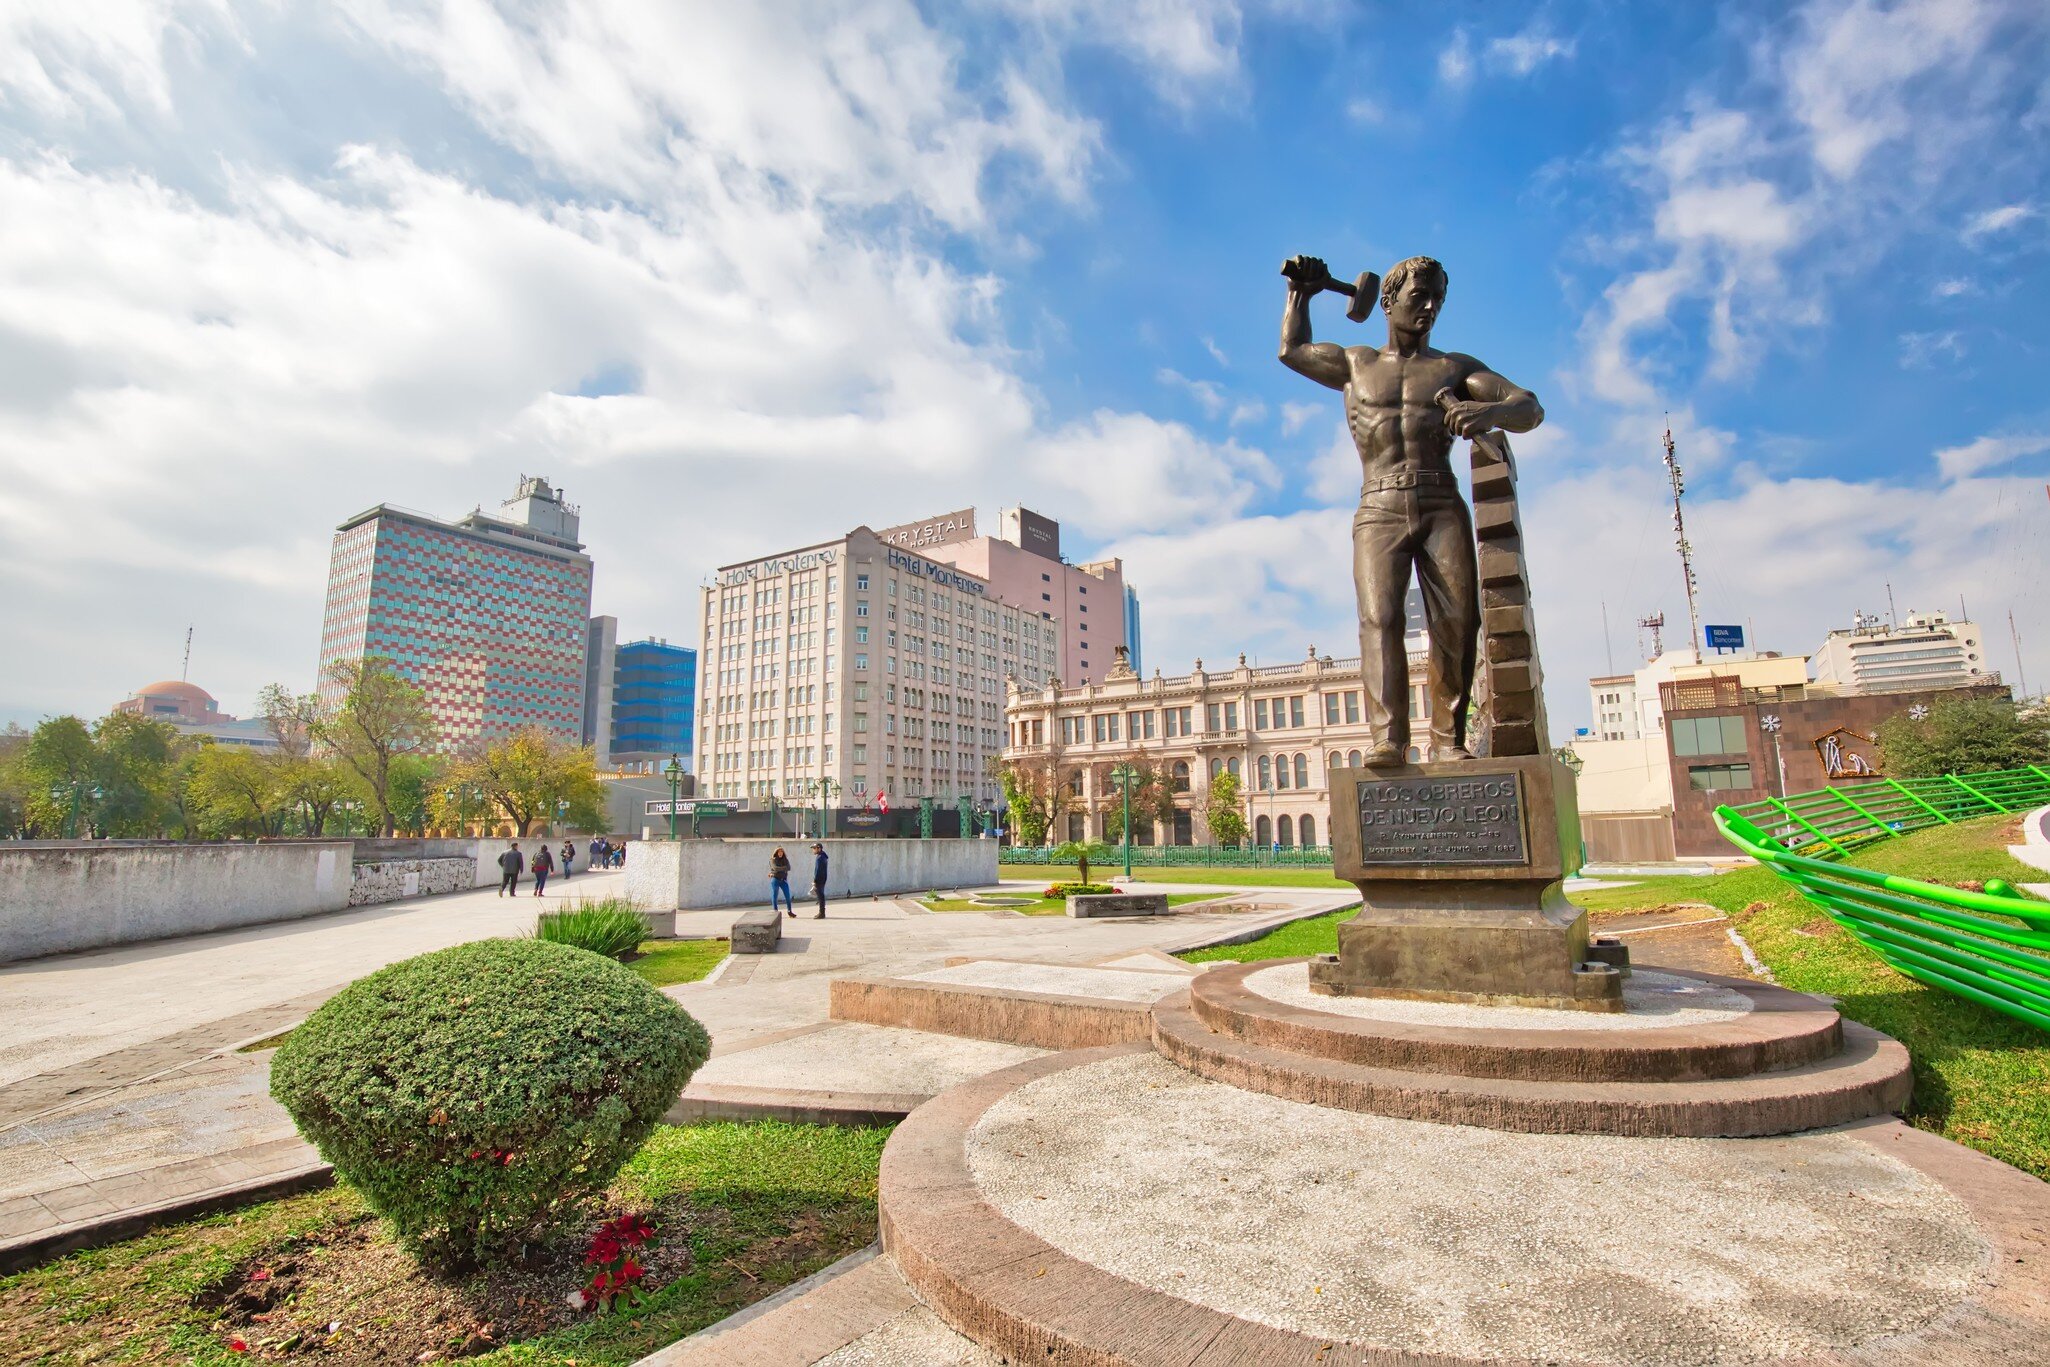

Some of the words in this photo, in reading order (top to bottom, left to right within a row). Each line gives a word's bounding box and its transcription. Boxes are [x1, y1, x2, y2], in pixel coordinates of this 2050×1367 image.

[887, 518, 969, 545] KRYSTAL
[910, 535, 945, 548] HOTEL
[726, 564, 758, 586] Hotel
[764, 549, 838, 577] Monterrey
[888, 548, 921, 575] Hotel
[925, 562, 985, 594] Monterrey
[1361, 787, 1373, 804] A
[1378, 786, 1413, 803] LOS
[1417, 780, 1516, 802] OBREROS
[656, 802, 671, 812] Hotel
[1361, 809, 1385, 826] DE
[1391, 807, 1457, 826] NUEVO
[1461, 804, 1519, 823] LEON
